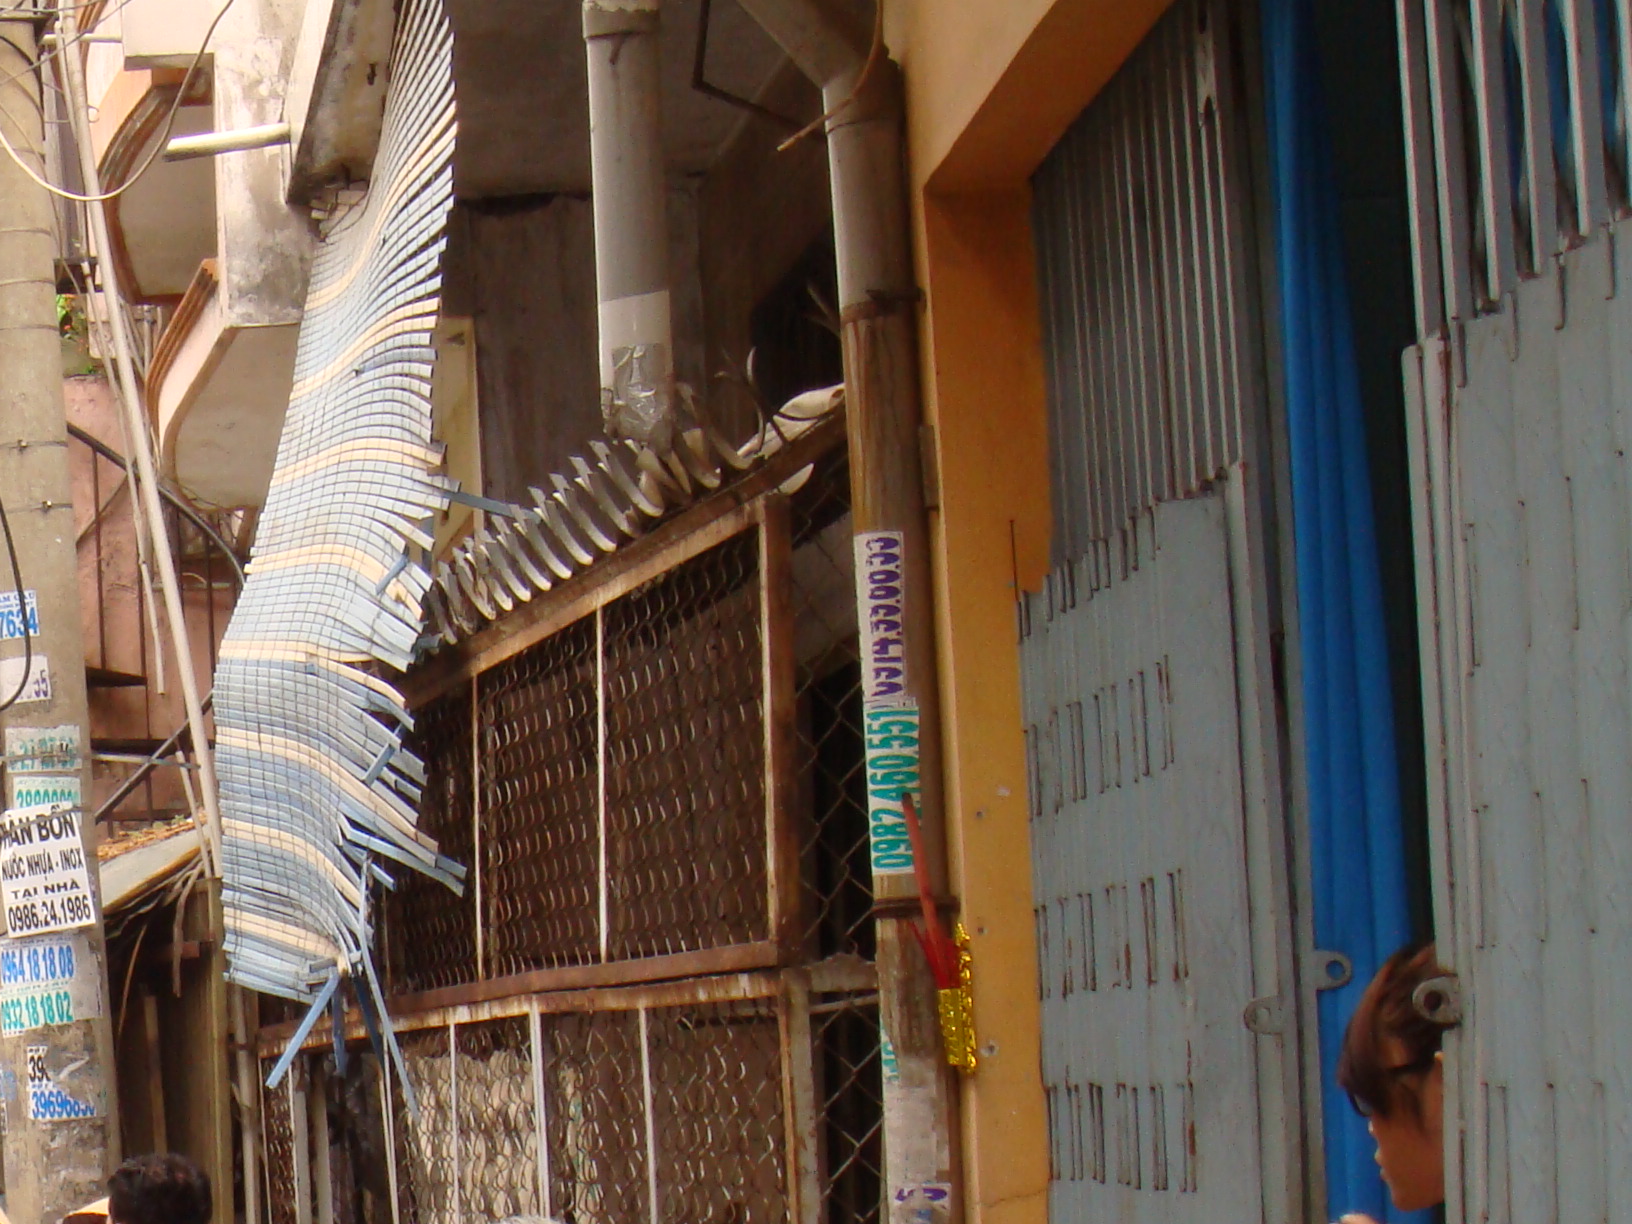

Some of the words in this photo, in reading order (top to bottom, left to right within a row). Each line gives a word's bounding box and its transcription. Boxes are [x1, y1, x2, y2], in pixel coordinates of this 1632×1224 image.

[59, 847, 84, 871] INOX
[11, 886, 39, 901] TẠI
[44, 878, 81, 895] NHÀ
[8, 894, 91, 933] 0986.24.1986
